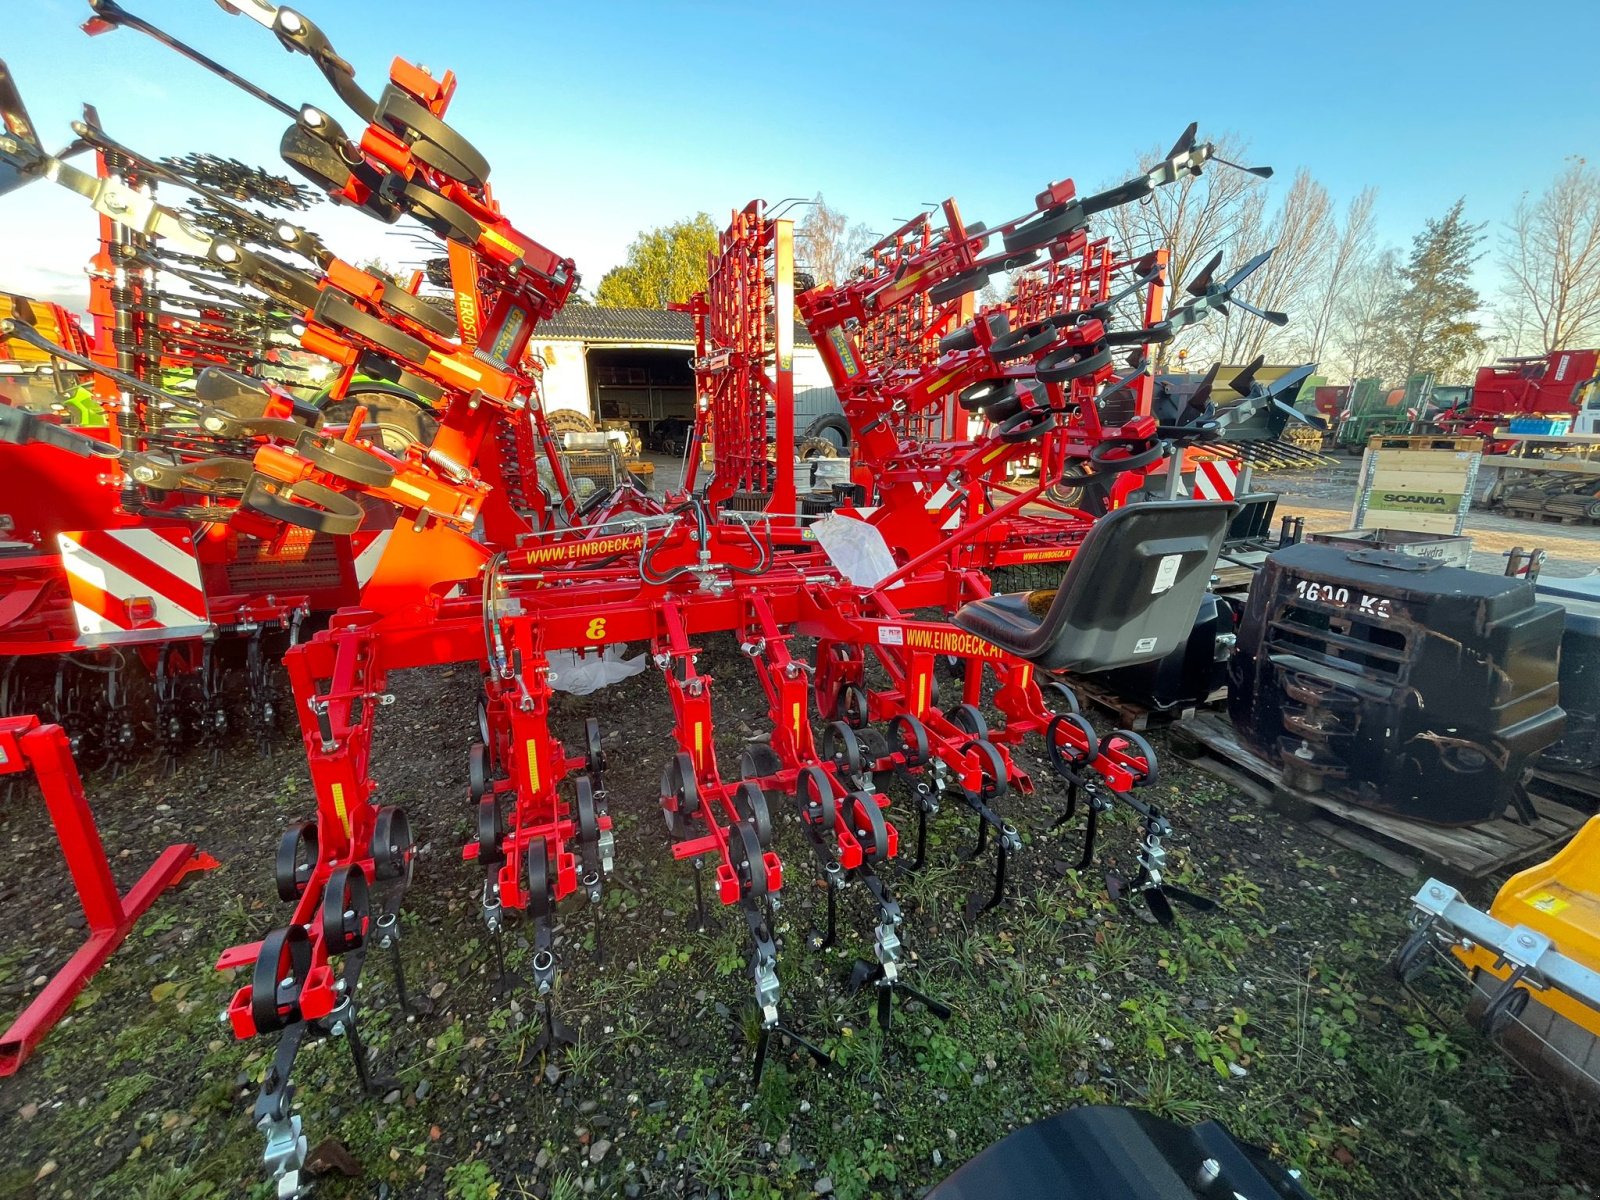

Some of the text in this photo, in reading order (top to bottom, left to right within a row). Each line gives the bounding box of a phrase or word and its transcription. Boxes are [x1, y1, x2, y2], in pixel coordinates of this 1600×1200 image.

[457, 291, 479, 349] AEROSTA
[1383, 494, 1446, 505] SCANIA
[526, 535, 643, 565] WWW.EINBOECK.A
